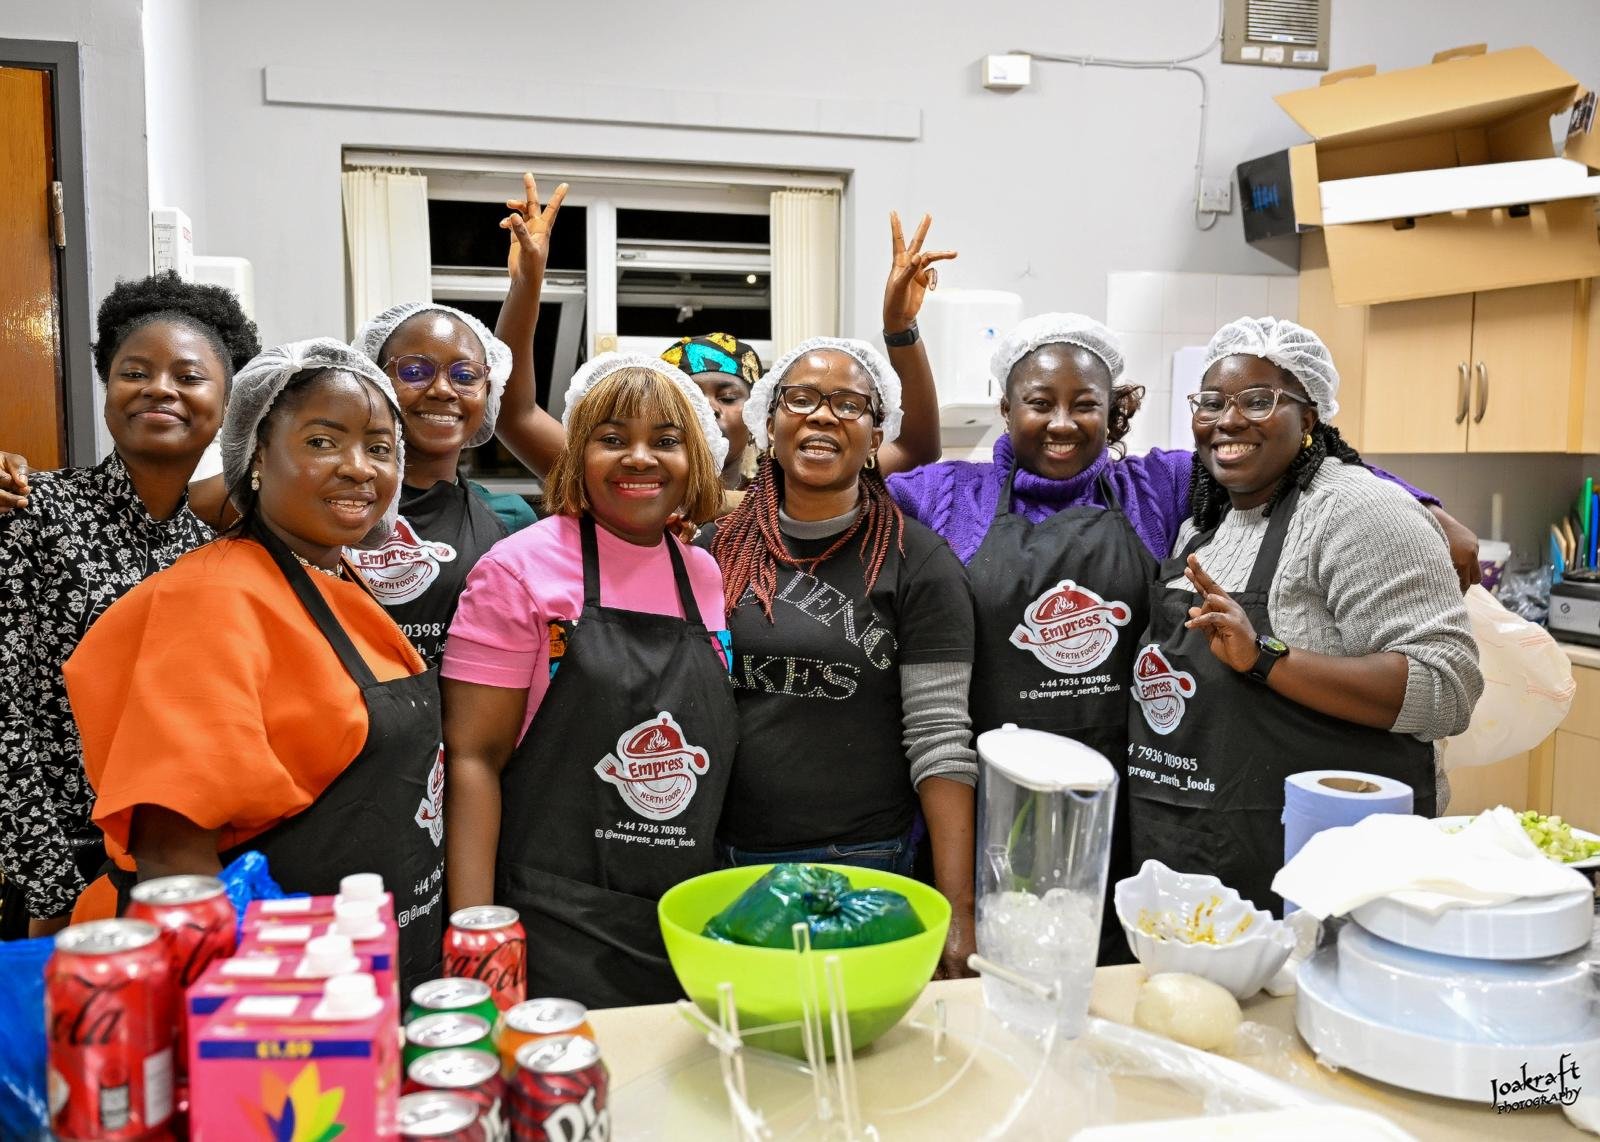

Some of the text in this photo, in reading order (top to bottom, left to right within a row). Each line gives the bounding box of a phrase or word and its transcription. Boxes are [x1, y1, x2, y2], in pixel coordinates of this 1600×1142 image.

[359, 548, 422, 567] Empress
[395, 572, 419, 590] FOODS
[1040, 613, 1101, 642] Empress
[1080, 640, 1101, 658] FOODS
[1040, 674, 1111, 688] +44 7936 703985
[1138, 745, 1163, 763] 7936
[628, 757, 683, 779] Empress
[640, 787, 682, 804] NERTH FOODS
[616, 821, 687, 836] +44 7936 703985
